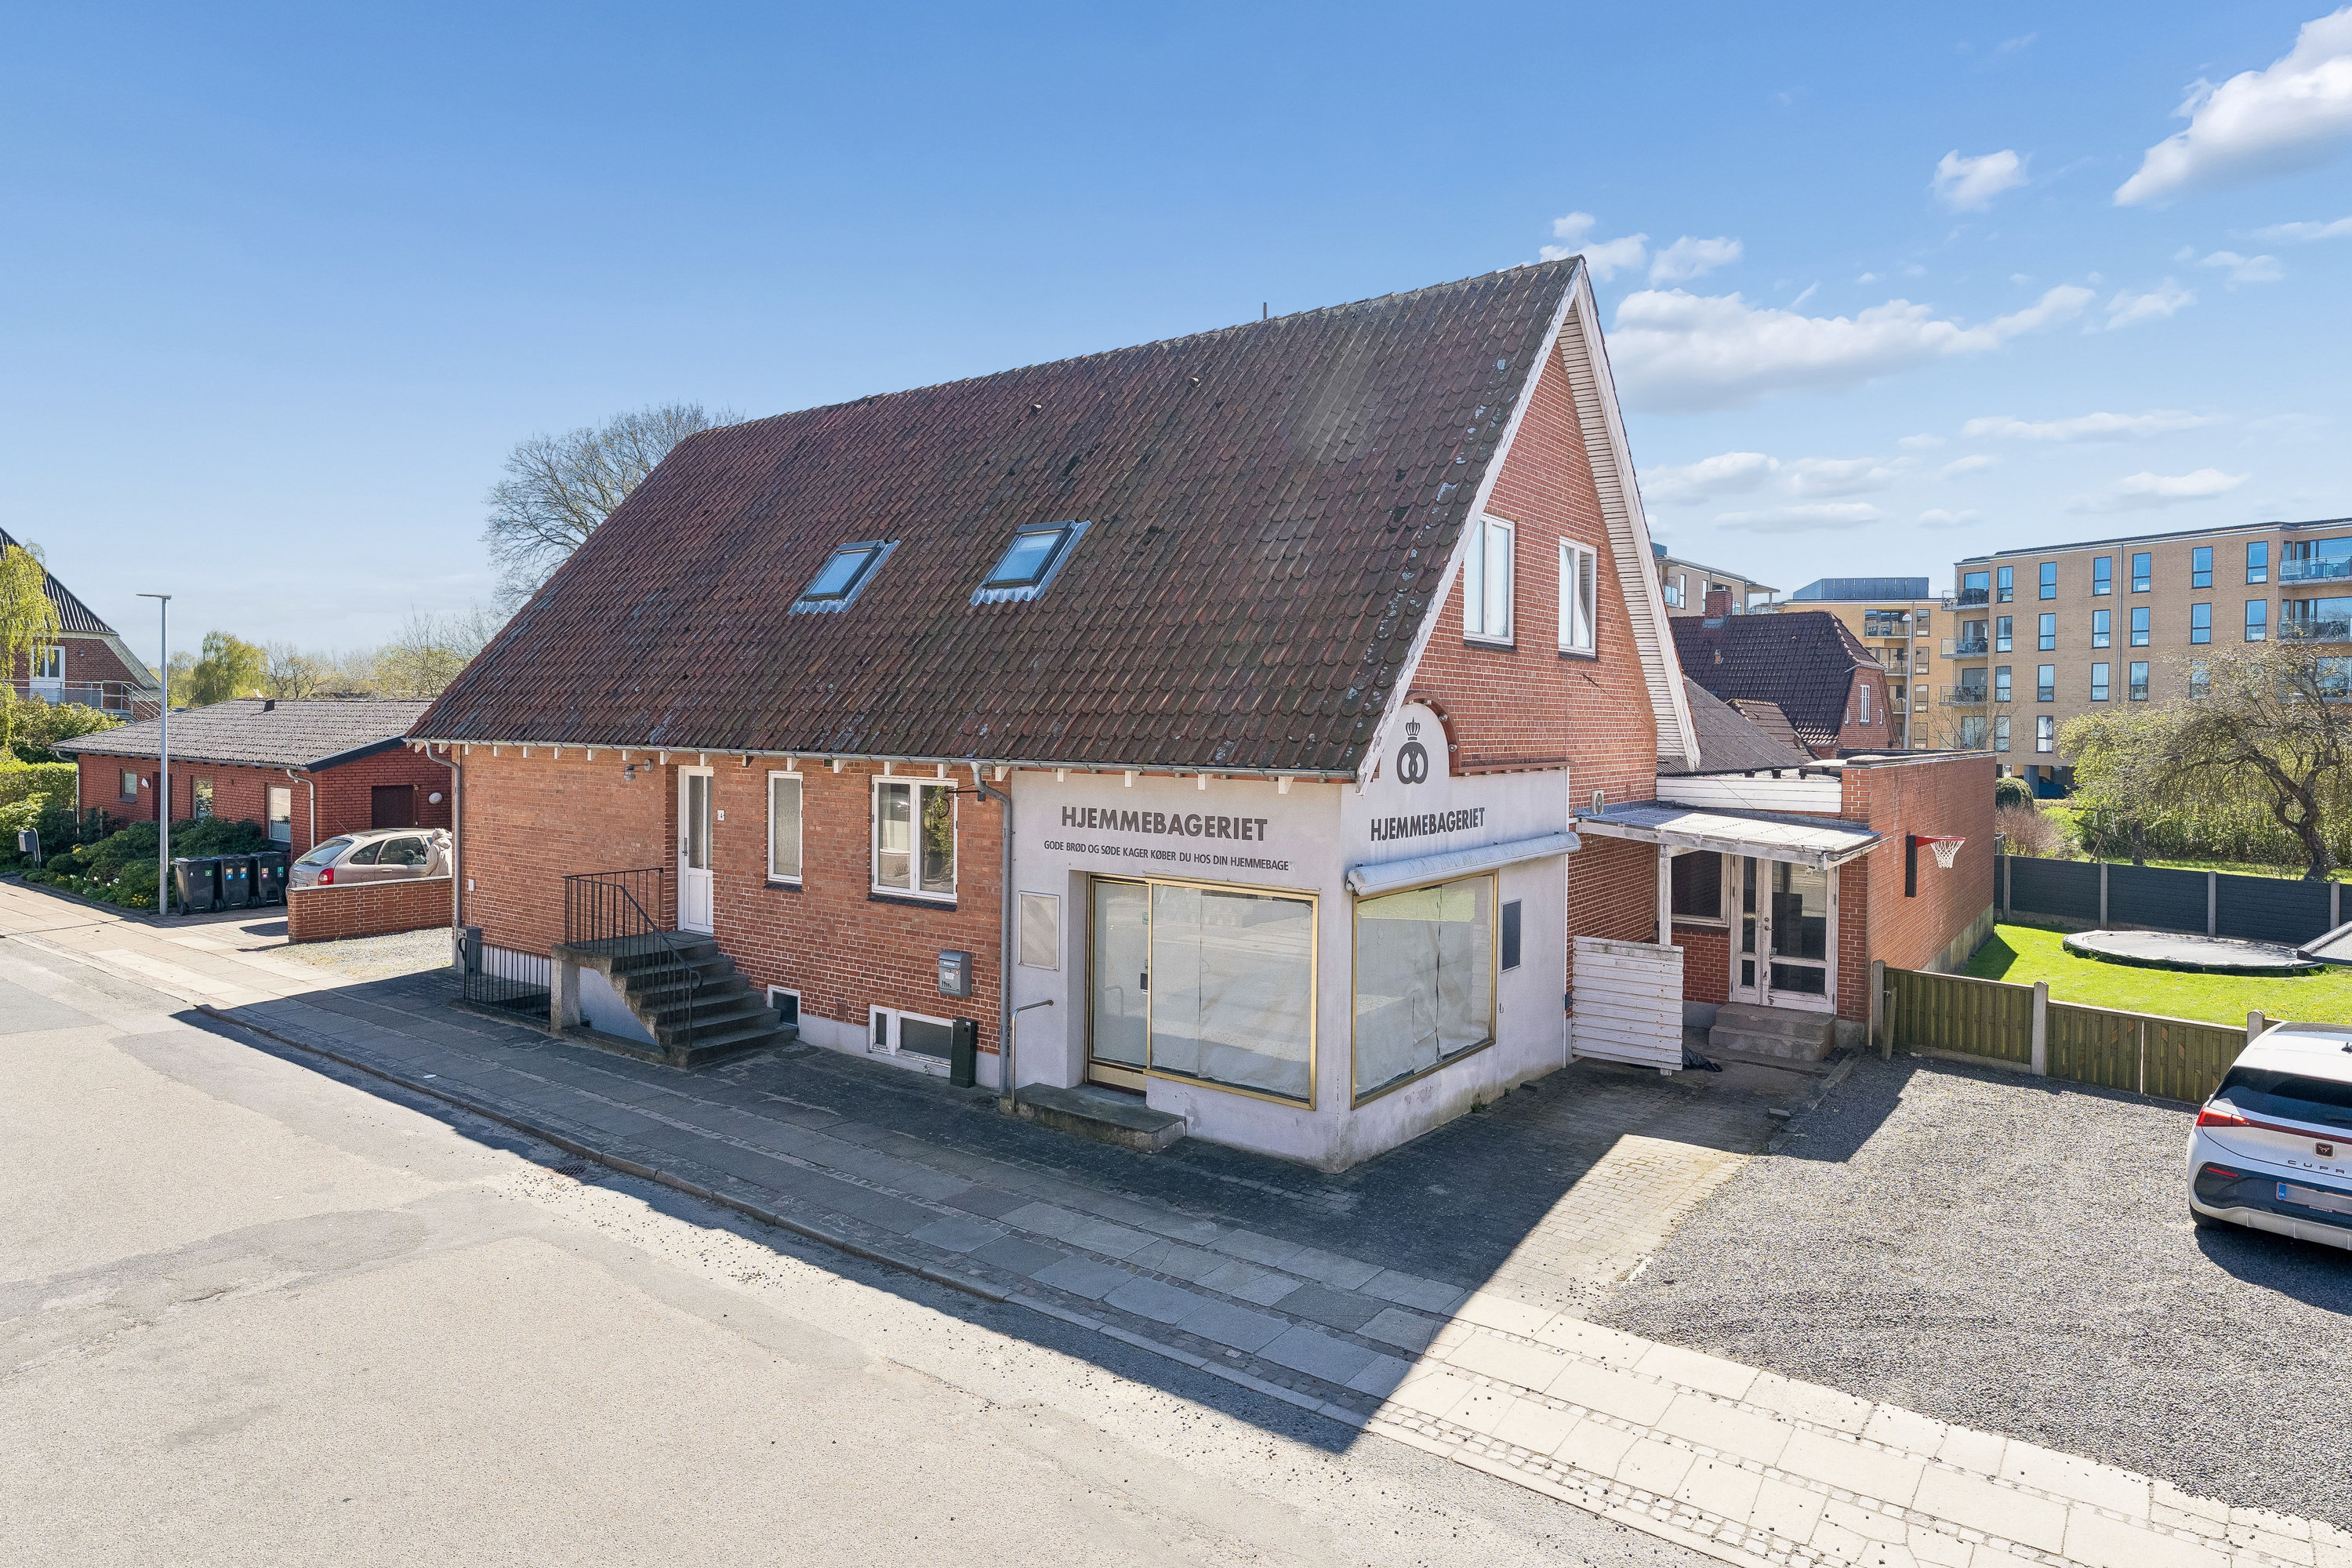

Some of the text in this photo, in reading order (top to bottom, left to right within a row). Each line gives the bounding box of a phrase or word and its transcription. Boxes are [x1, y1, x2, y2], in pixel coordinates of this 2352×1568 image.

[1062, 805, 1269, 841] HJEMMEBAGERIET
[1370, 807, 1486, 841] HJEMMEBAGERIET
[1044, 840, 1294, 871] GODE BRØD OG SØDE KAGER KØBER DU HOS DIN HJEMMEBAGE
